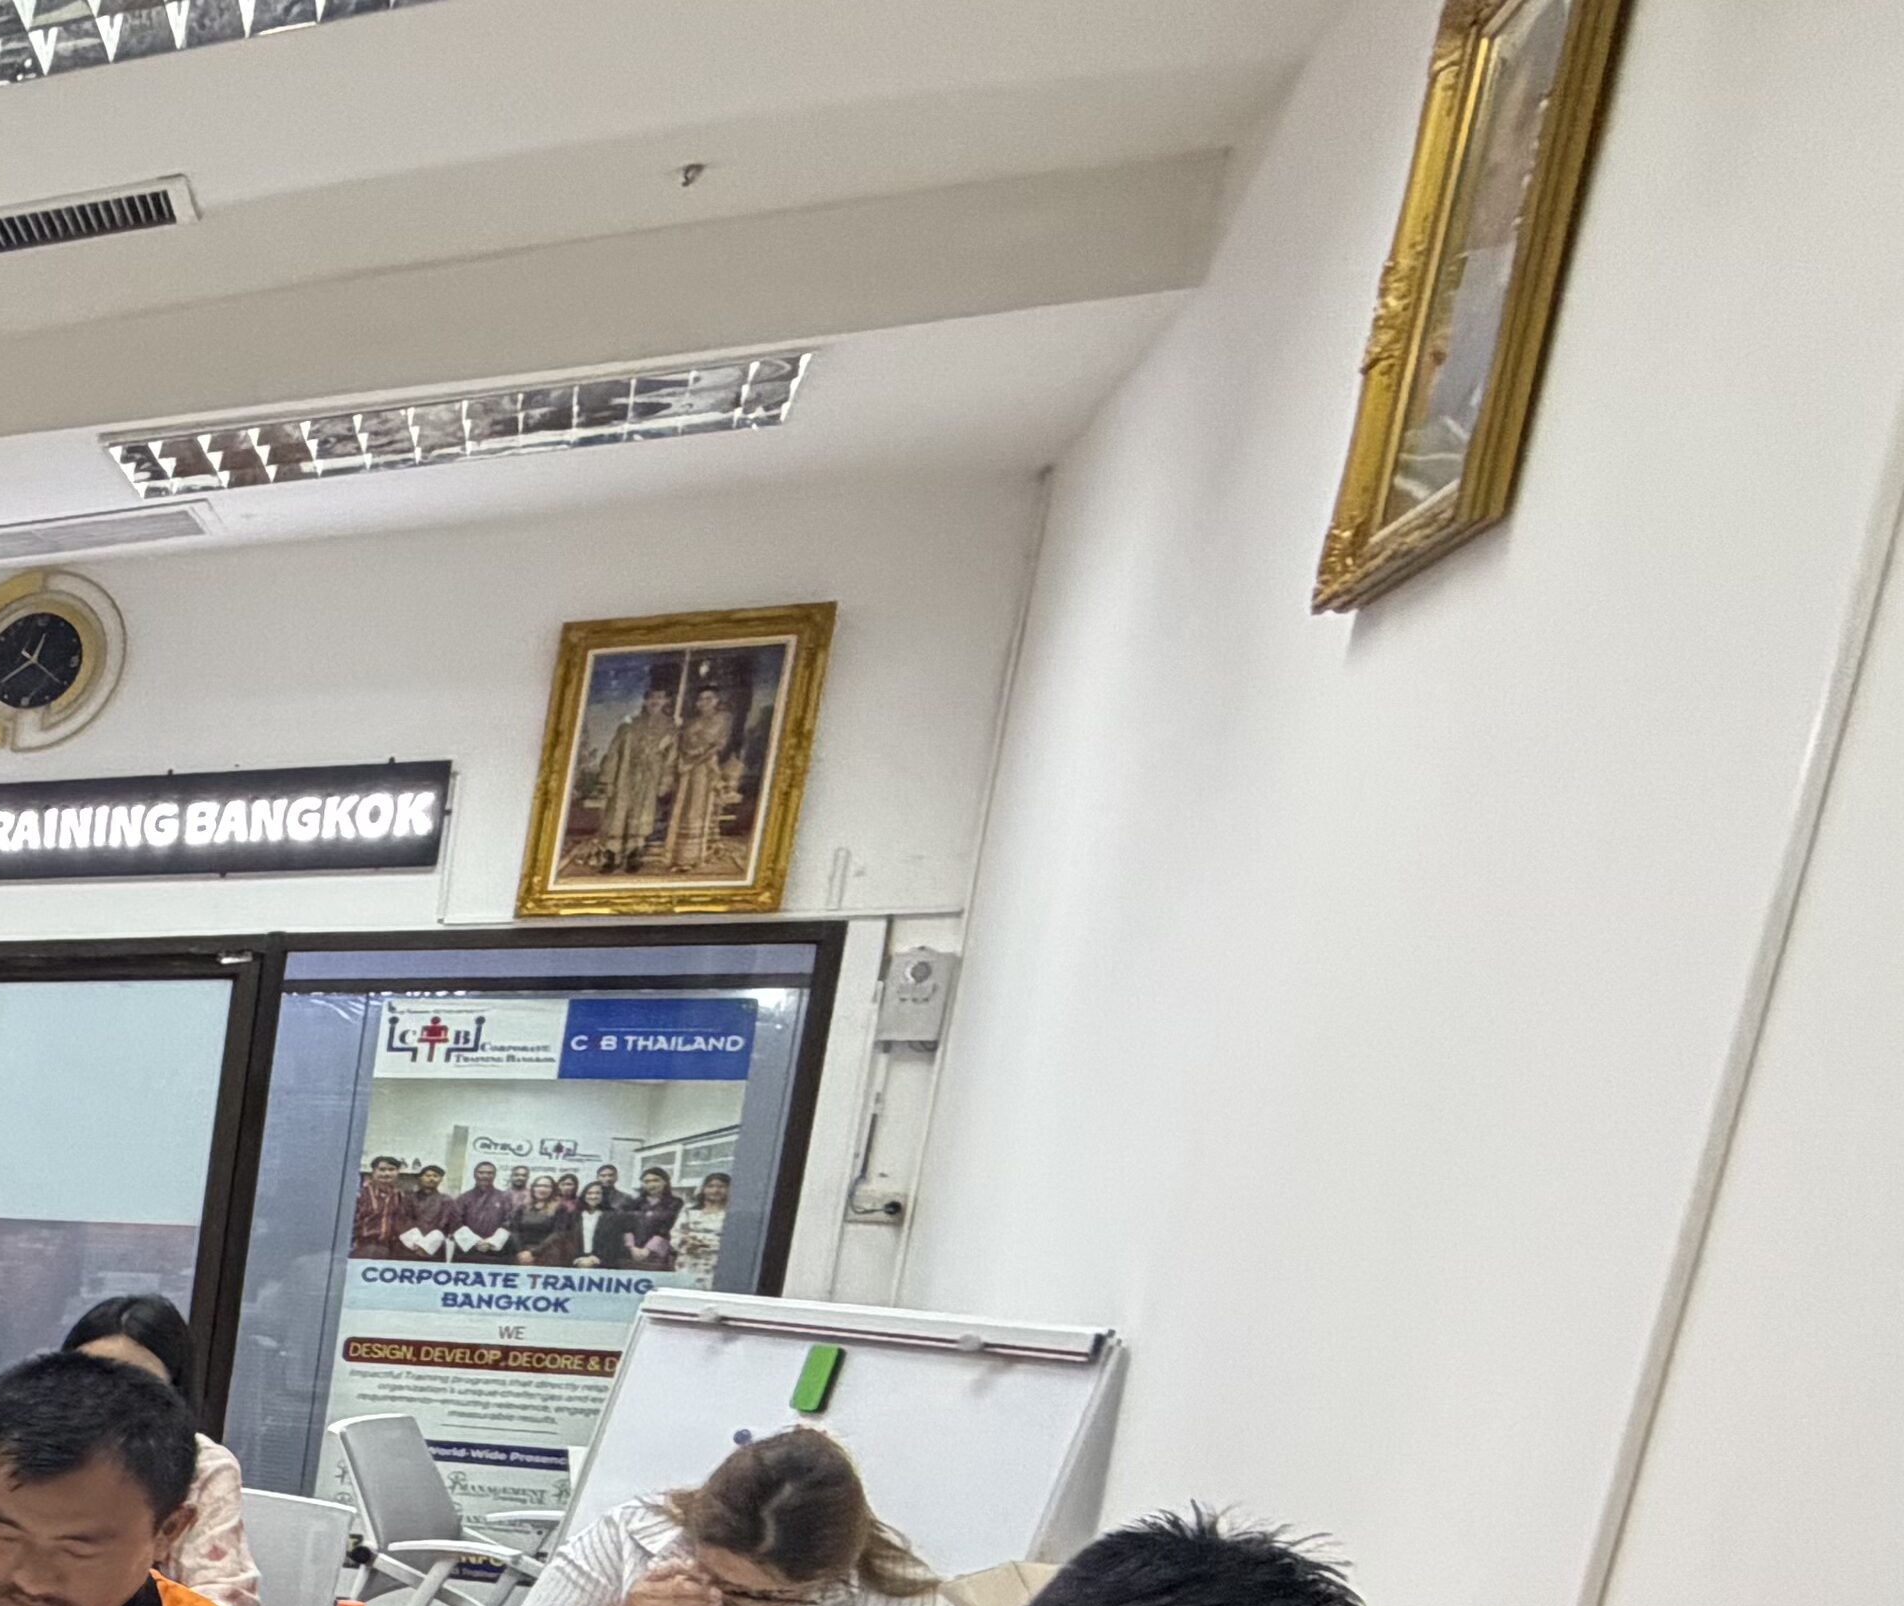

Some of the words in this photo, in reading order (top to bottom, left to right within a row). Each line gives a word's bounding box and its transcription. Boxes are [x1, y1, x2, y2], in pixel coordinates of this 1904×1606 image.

[186, 790, 437, 845] BANGKOK
[624, 1035, 745, 1052] THAILAND
[360, 1266, 520, 1289] CORPORATE
[526, 1273, 655, 1296] TRAINING
[441, 1291, 571, 1314] BANGKOK
[497, 1325, 526, 1341] WE
[508, 1351, 584, 1371] DECORE
